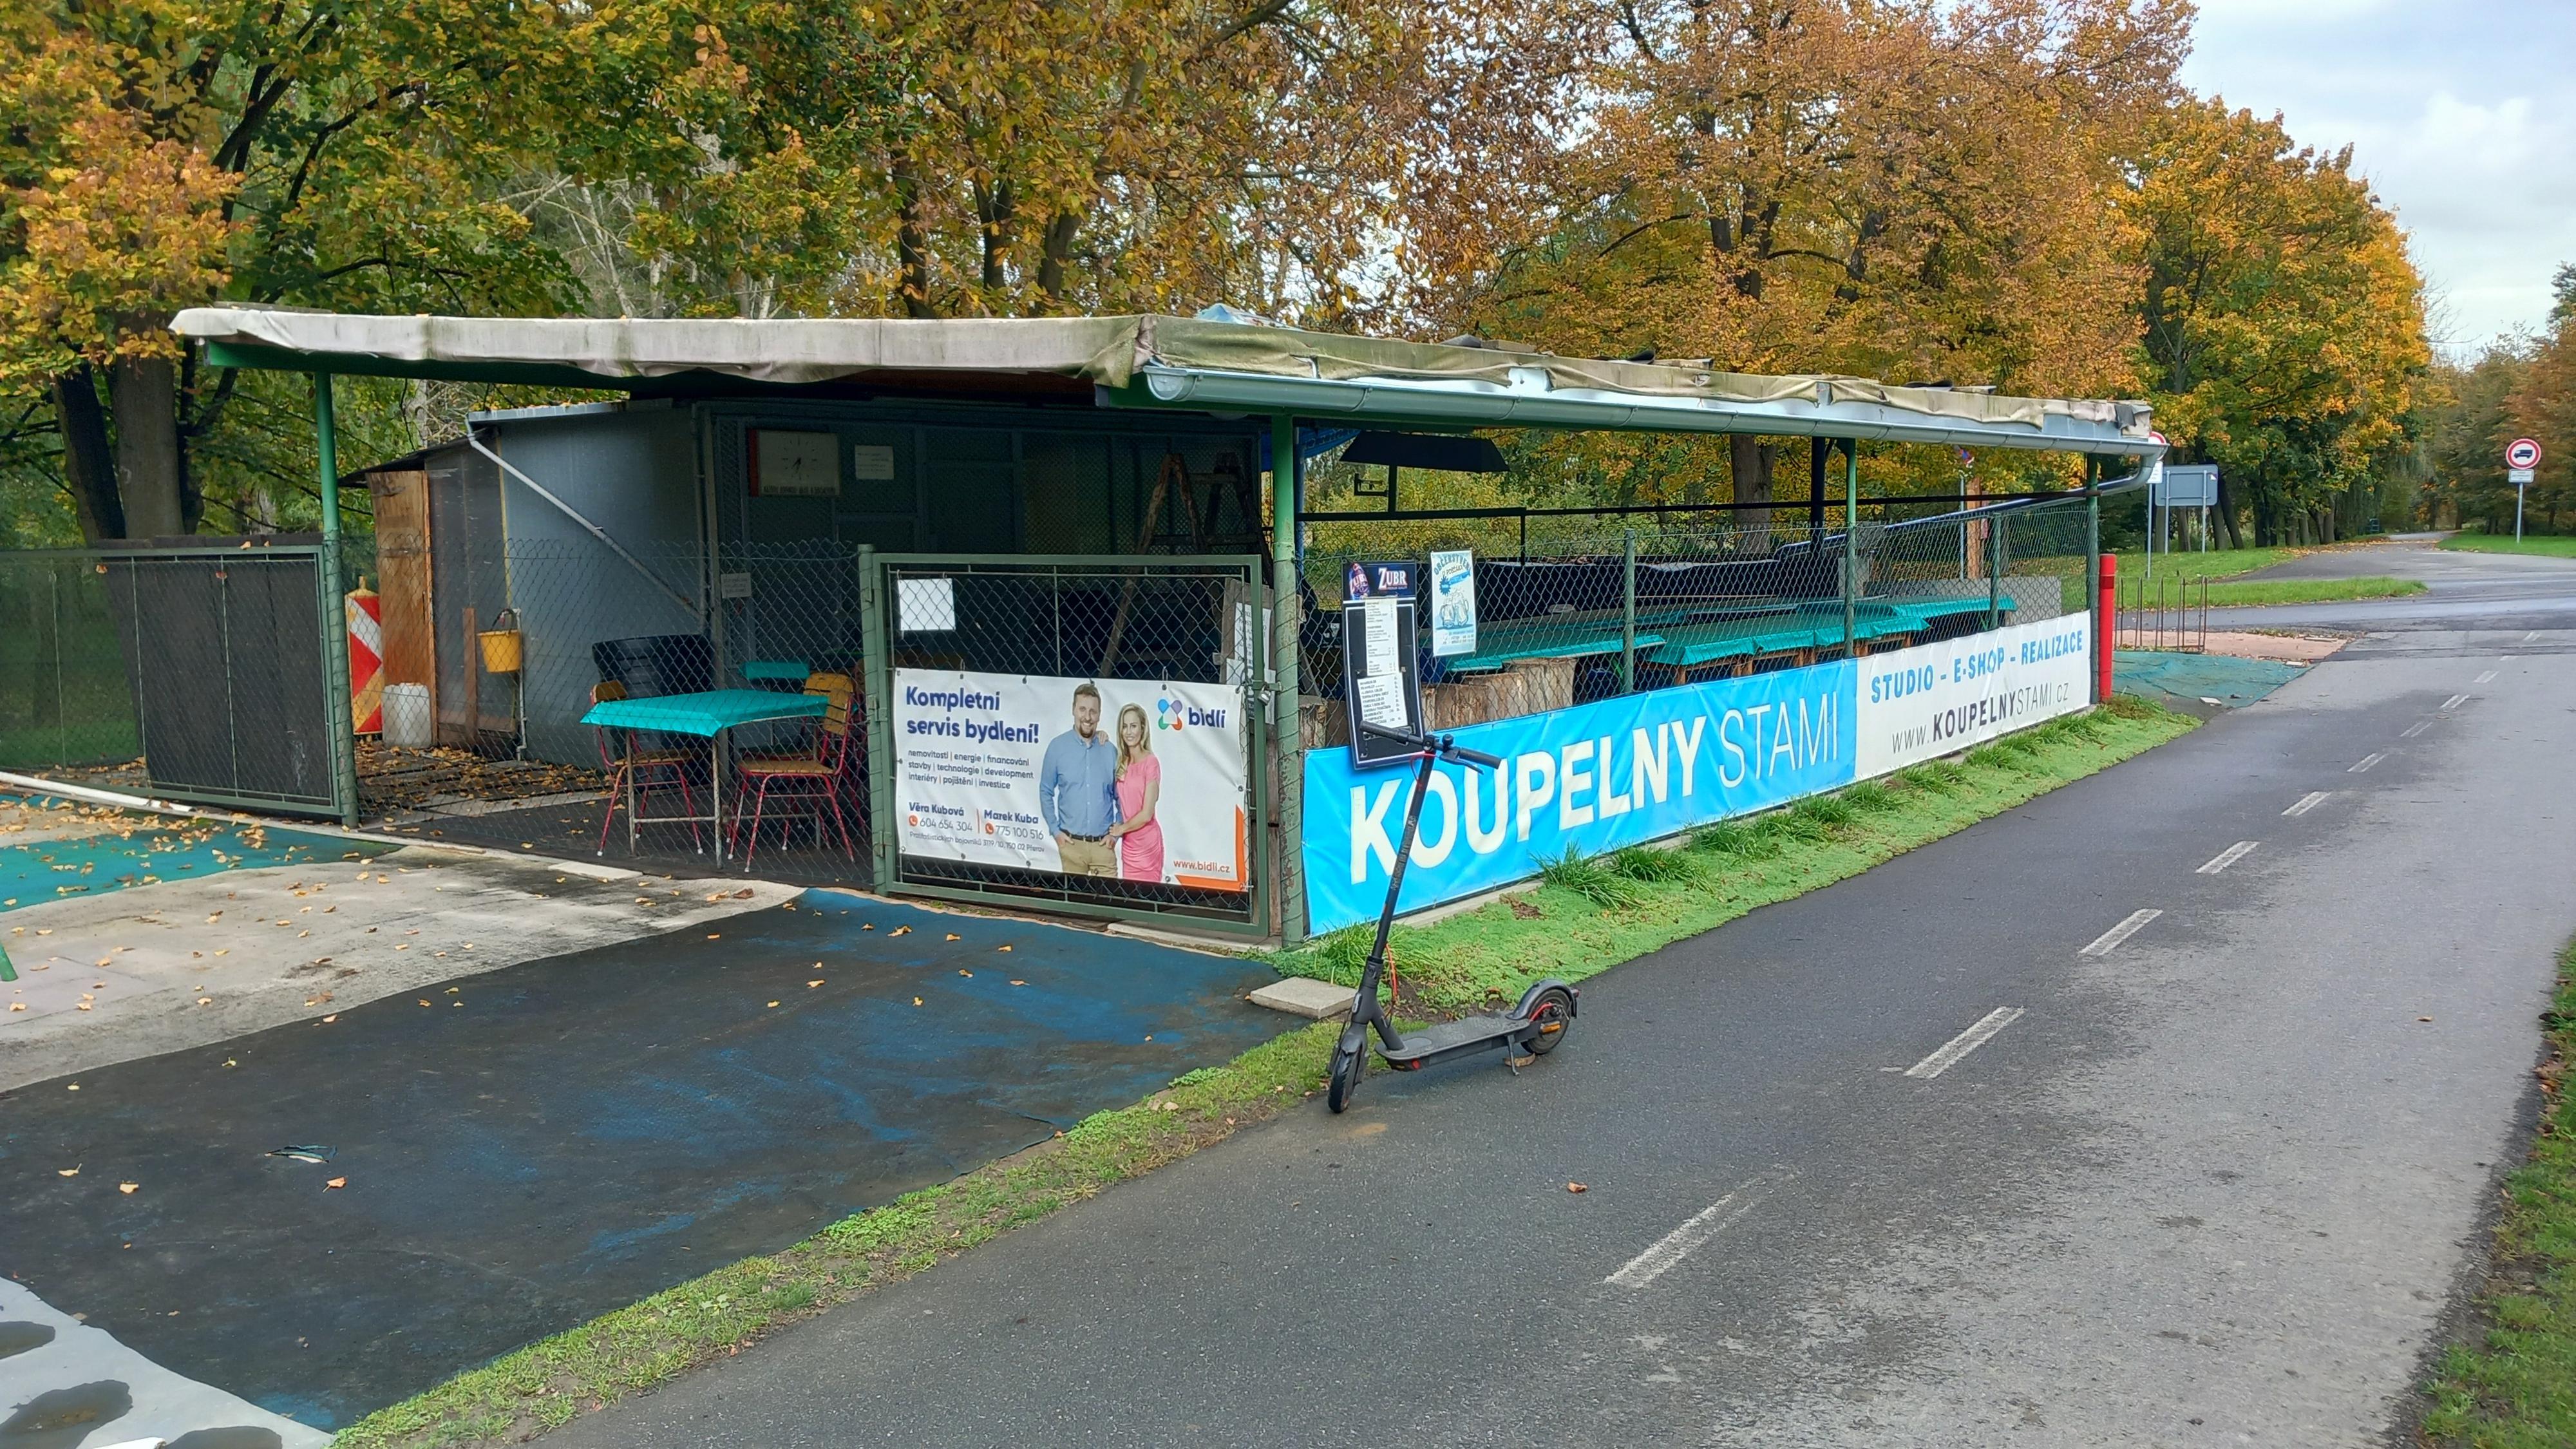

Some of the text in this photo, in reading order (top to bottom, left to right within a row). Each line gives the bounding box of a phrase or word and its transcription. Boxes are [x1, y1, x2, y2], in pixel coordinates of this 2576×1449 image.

[1378, 567, 1408, 591] ZUBR
[1871, 665, 1933, 703] STUDIO
[1954, 647, 2004, 683] E-SHOP
[2022, 630, 2083, 665] REALIZACE
[906, 686, 1000, 712] Kompletní
[1188, 707, 1226, 728] bidli
[907, 716, 1039, 744] servis bydlení!
[908, 750, 1030, 766] nemovitosti energie financování
[908, 761, 1034, 779] stavby technologie development
[909, 772, 1010, 790] interiéry pojištění investice
[1350, 715, 1708, 885] KOUPELNY
[1719, 690, 1838, 789] STAMI
[909, 801, 964, 817] Věra Kubová
[984, 809, 1039, 824] Marek Kuba
[920, 817, 972, 831] 604 654 304
[996, 825, 1045, 840] 775 100 516
[1173, 859, 1231, 874] www.bidli.cz
